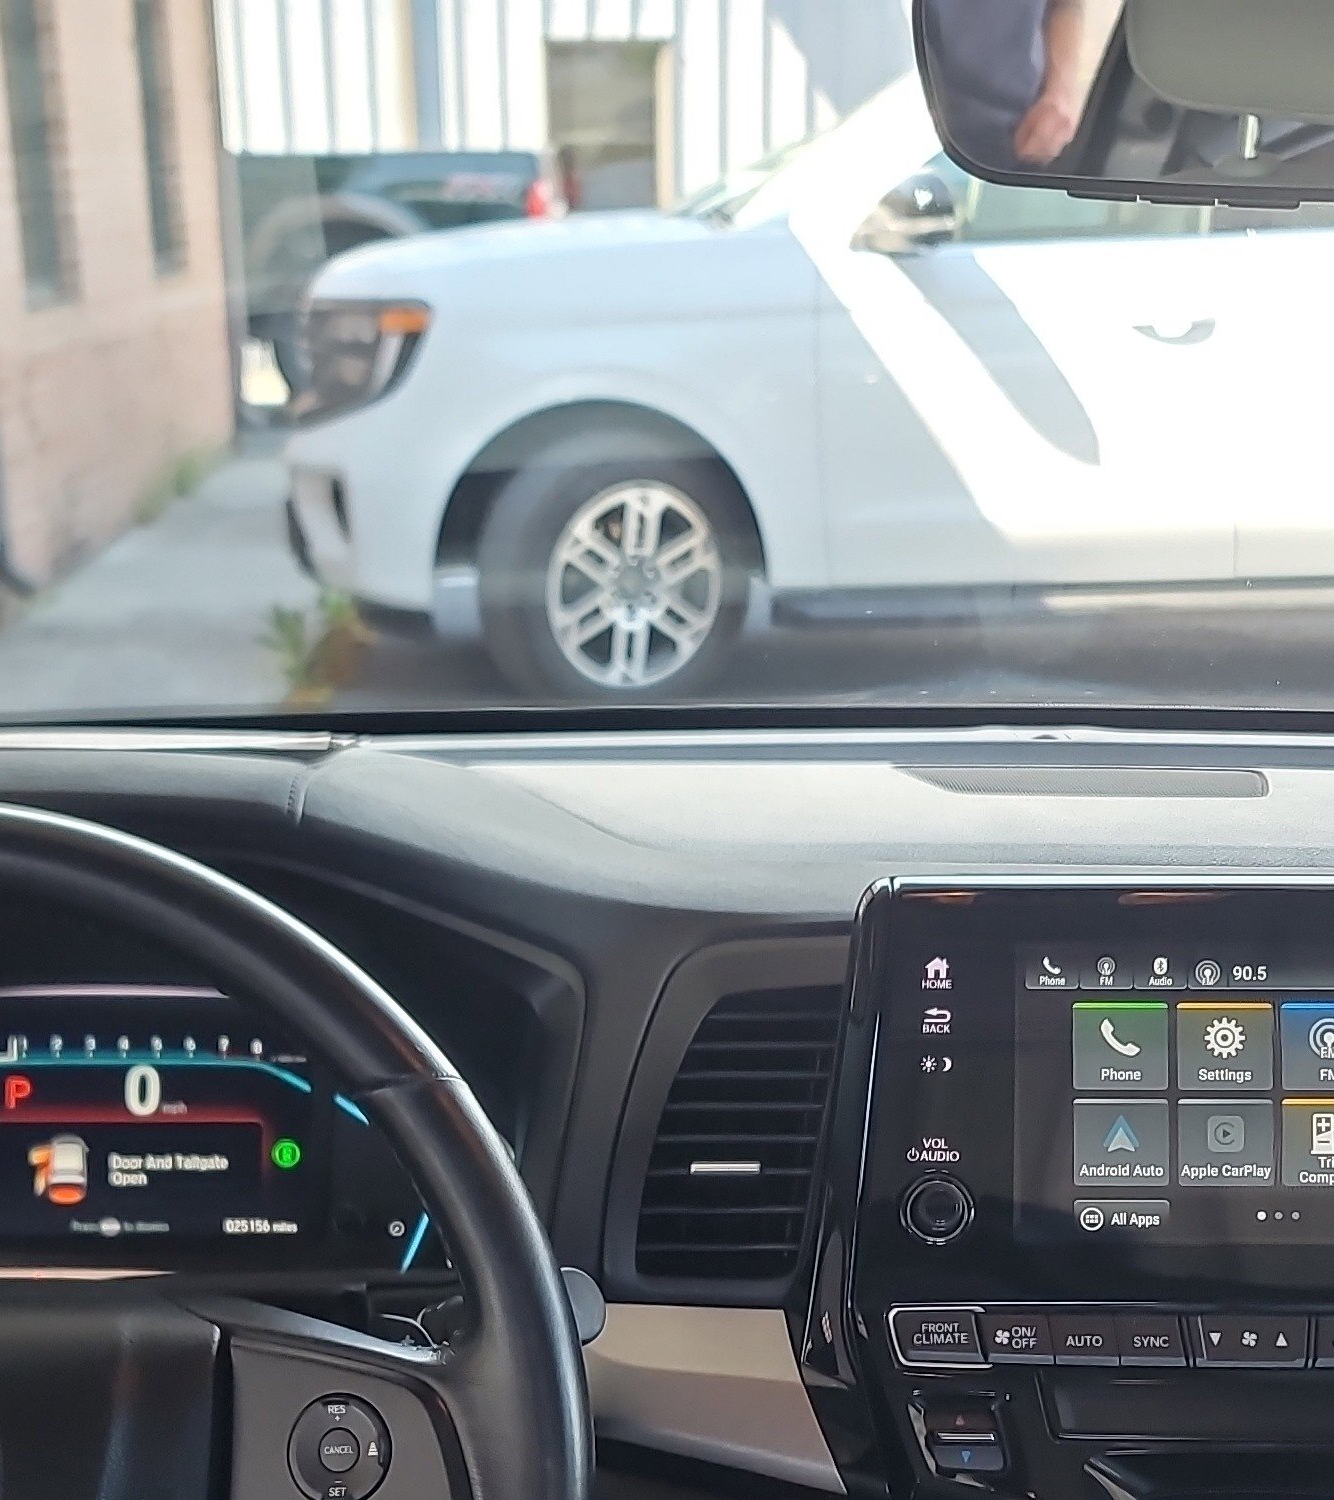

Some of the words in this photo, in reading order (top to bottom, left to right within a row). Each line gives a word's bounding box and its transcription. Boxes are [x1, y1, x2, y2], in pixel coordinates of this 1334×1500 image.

[1232, 965, 1267, 981] 90.5
[922, 979, 953, 990] HOME
[1039, 976, 1065, 986] Phone
[1099, 976, 1114, 986] FM
[1149, 976, 1172, 986] Audio
[922, 1024, 951, 1034] BACK
[1101, 1068, 1142, 1081] Phone
[1198, 1068, 1252, 1083] Settings
[5, 1075, 31, 1110] P
[124, 1065, 161, 1117] 0
[922, 1138, 948, 1149] VOL
[109, 1153, 144, 1171] Door
[146, 1153, 173, 1171] And
[920, 1150, 960, 1162] AUDIO
[1079, 1164, 1130, 1177] Android
[1132, 1165, 1164, 1177] Auto
[1181, 1164, 1219, 1179] Apple
[1221, 1164, 1272, 1179] CarPlay
[108, 1171, 148, 1187] Open
[1111, 1212, 1127, 1225] All
[1129, 1213, 1160, 1228] Apps
[921, 1322, 960, 1334] FRONT
[1011, 1326, 1037, 1338] ON/
[913, 1333, 969, 1345] CLIMATE
[1011, 1338, 1038, 1349] OFF
[1066, 1335, 1103, 1347] AUTO
[1133, 1335, 1170, 1348] SYNC
[328, 1405, 346, 1414] RES
[324, 1446, 354, 1455] CANCEL
[328, 1487, 347, 1497] SET
